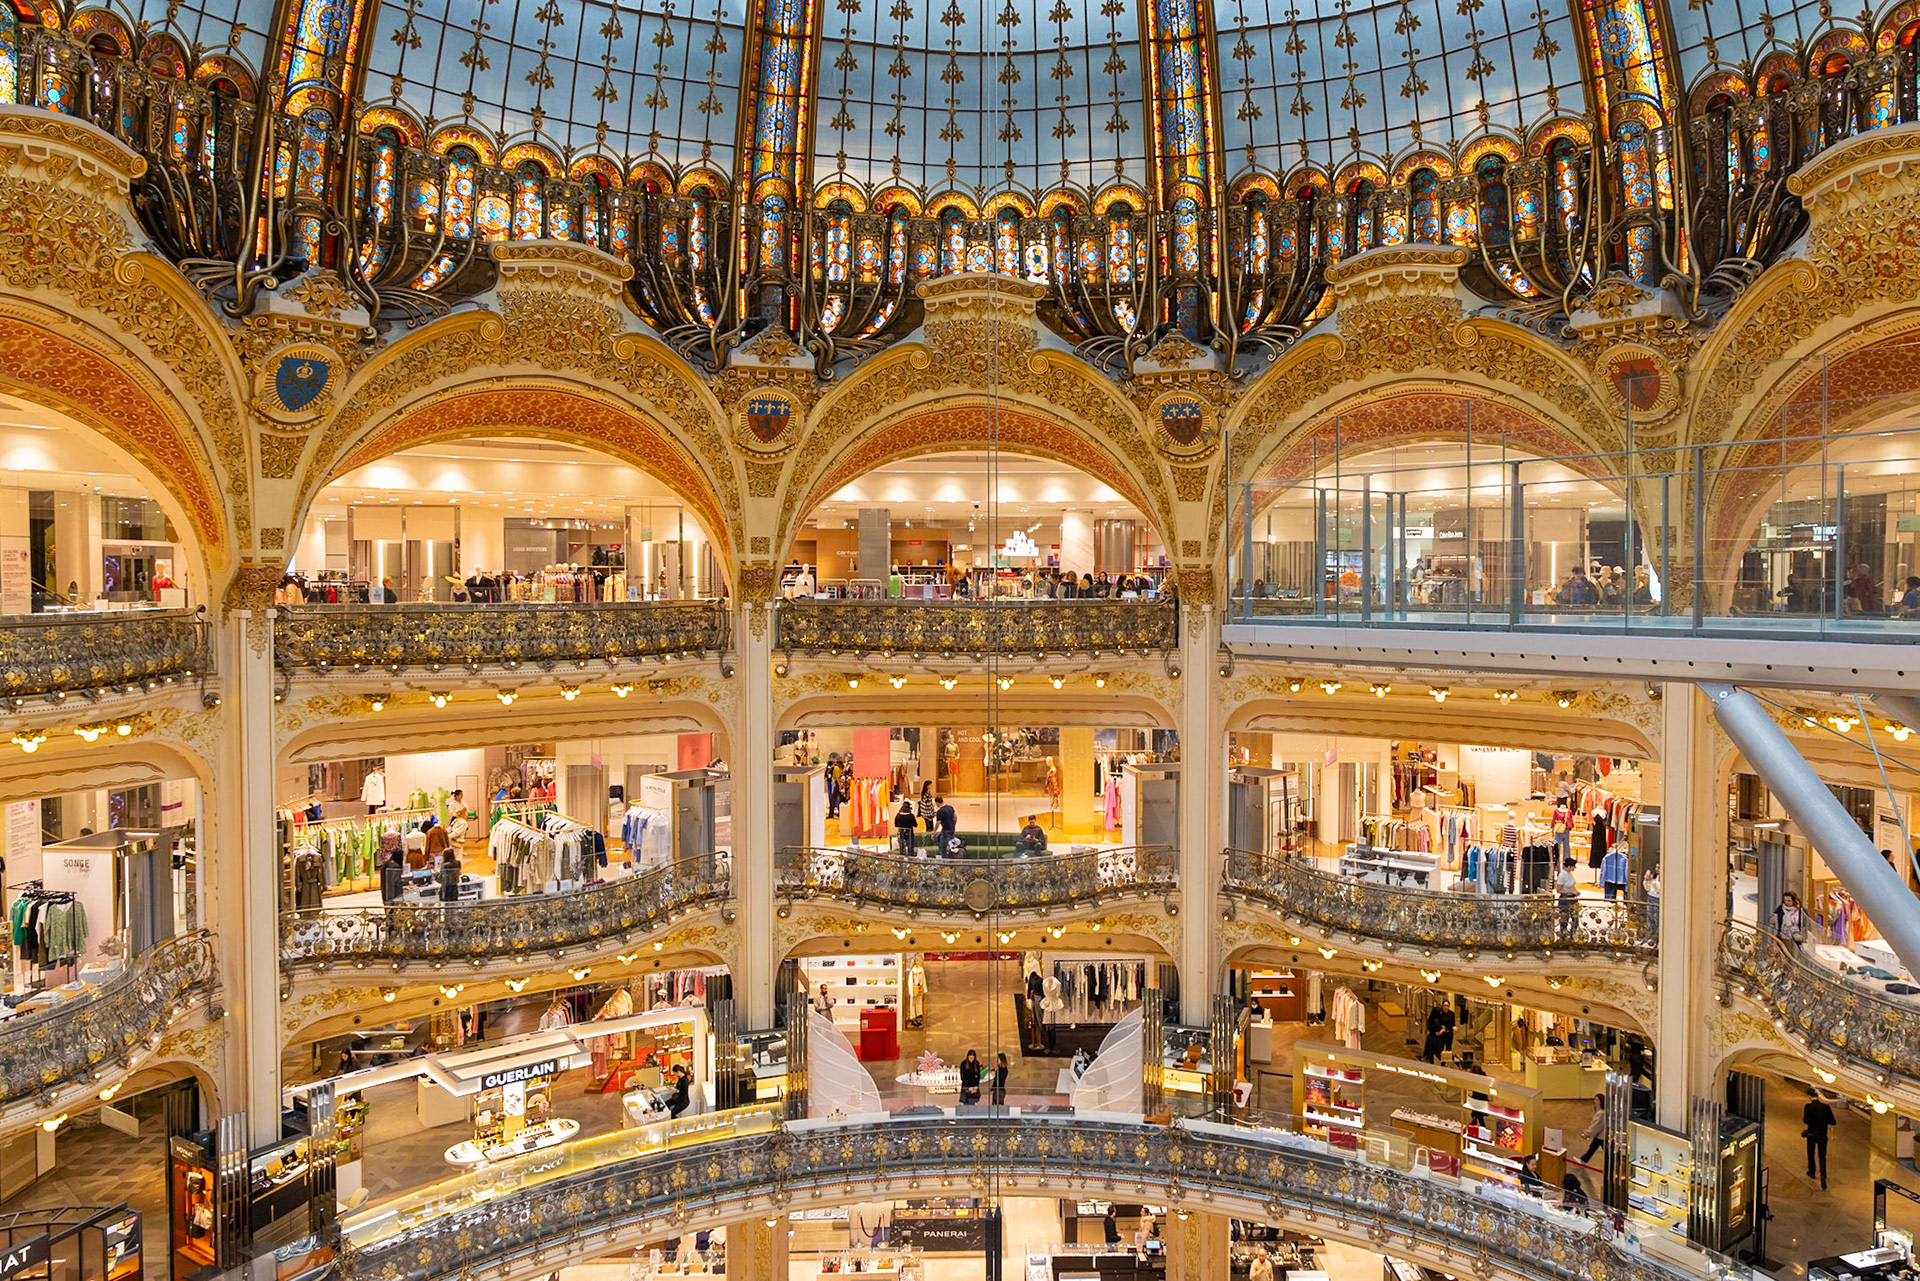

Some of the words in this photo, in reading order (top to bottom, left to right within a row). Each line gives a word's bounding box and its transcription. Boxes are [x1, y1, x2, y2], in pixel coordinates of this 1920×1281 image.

[63, 859, 90, 868] SONGE
[485, 1061, 554, 1088] GUERLAIN
[1739, 1133, 1757, 1148] CHANEL
